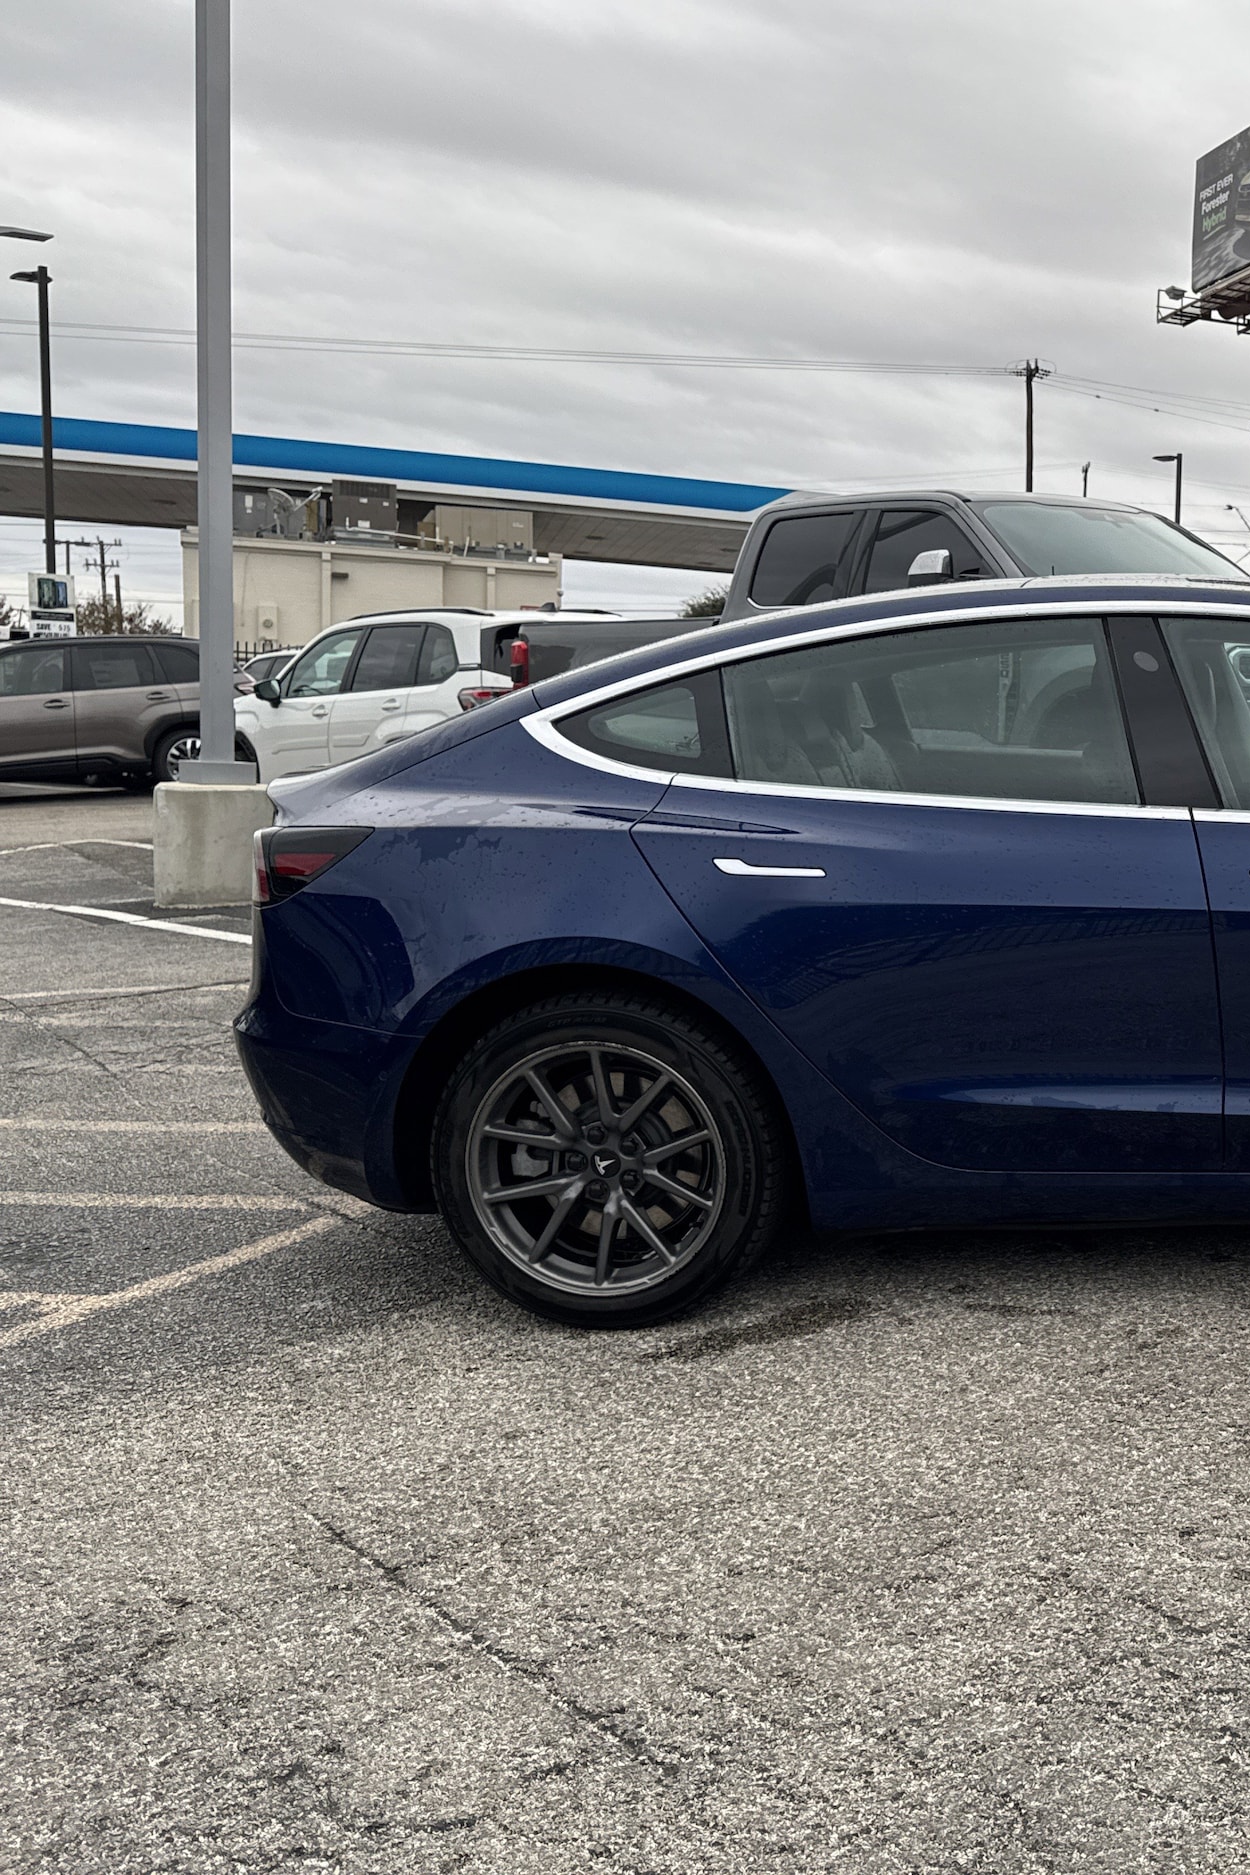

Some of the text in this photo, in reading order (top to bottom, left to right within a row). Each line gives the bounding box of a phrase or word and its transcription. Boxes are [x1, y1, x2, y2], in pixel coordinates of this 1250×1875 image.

[1200, 173, 1234, 202] FIRST EVER
[1201, 191, 1230, 215] Forester
